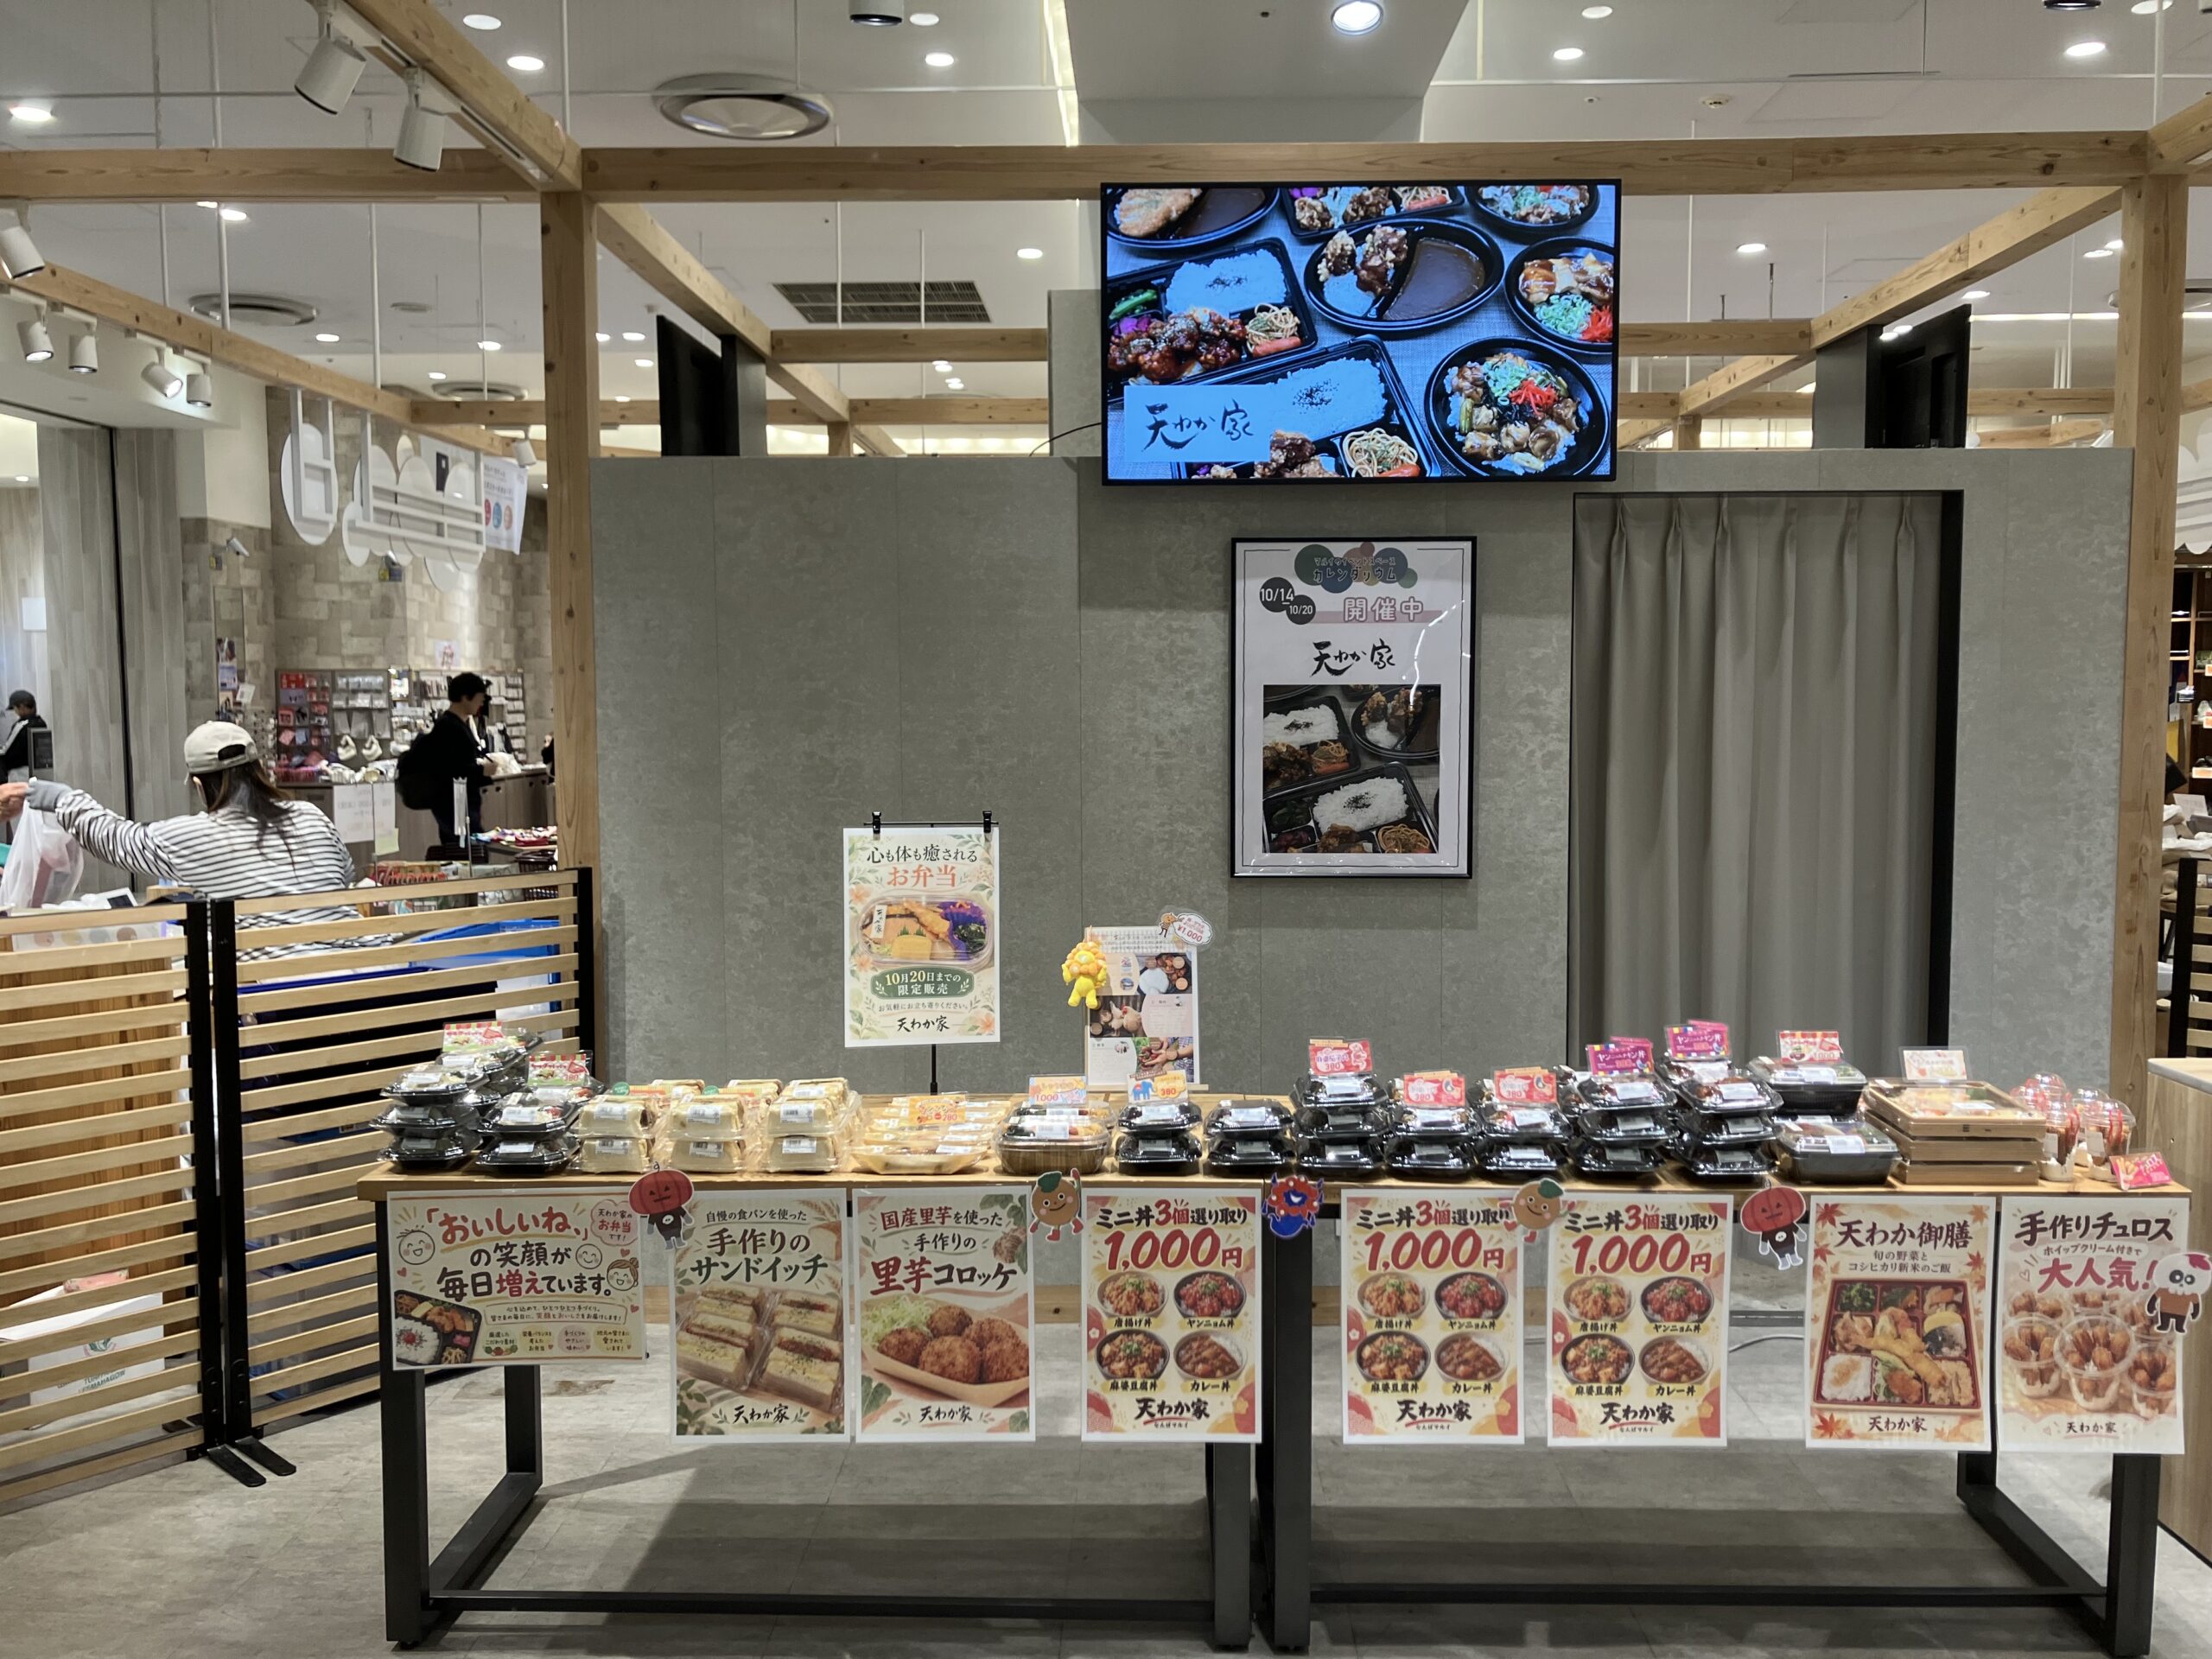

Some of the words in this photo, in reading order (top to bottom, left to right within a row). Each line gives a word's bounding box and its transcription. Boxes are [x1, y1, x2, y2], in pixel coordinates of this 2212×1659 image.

[1143, 399, 1254, 452] 天わか家
[1313, 566, 1397, 583] カレンダリウム
[1260, 588, 1294, 602] 10/14
[1288, 605, 1313, 615] 10/20
[1344, 596, 1424, 622] 開催中
[1310, 638, 1396, 677] 天わか家
[867, 844, 978, 864] 心も体も癒される
[886, 865, 957, 887] お弁当
[885, 970, 962, 986] 10月20日までの
[898, 983, 948, 996] 限定販売
[897, 1014, 950, 1033] 天わか家
[598, 1208, 632, 1219] 天わか家の
[705, 1208, 807, 1224] 自慢の食パンを使った
[880, 1206, 1004, 1231] 国産里芋を使った
[1096, 1198, 1248, 1229] ミニ丼3個選り取り
[1356, 1199, 1510, 1230] ミニ丼3個選り取り
[1564, 1204, 1719, 1233] ミニ丼3個選り取り
[598, 1219, 632, 1233] お弁当
[1834, 1219, 1974, 1250] 天わか御膳
[2014, 1210, 2174, 1246] 手作りチュロス
[706, 1227, 811, 1255] 手作りの
[913, 1233, 977, 1253] 手作りの
[1105, 1227, 1243, 1270] 1,000円
[1364, 1228, 1504, 1271] 1,000円
[2044, 1243, 2142, 1256] ホイップクリーム付きで
[470, 1240, 573, 1269] の笑顔が
[1572, 1233, 1712, 1275] 1,000円
[1873, 1250, 1929, 1262] 旬の野菜と
[690, 1254, 830, 1285] サンドイッチ
[869, 1255, 1018, 1296] 里芋コロッケ
[1848, 1262, 1952, 1274] コシヒカリ新米のご飯
[2037, 1256, 2159, 1294] 大人気!
[436, 1266, 612, 1303] 毎日増えています。
[1114, 1317, 1153, 1328] 唐揚げ丼
[1186, 1318, 1235, 1329] ヤンニョム丼
[1374, 1319, 1413, 1330] 唐揚げ丼
[1447, 1319, 1497, 1331] ヤンニョム丼
[1580, 1322, 1618, 1333] 唐揚げ丼
[1653, 1323, 1701, 1333] ヤンニョム丼
[1190, 1381, 1230, 1392] カレー丼
[1452, 1382, 1493, 1394] カレー丼
[1656, 1385, 1696, 1396] カレー丼
[732, 1403, 791, 1425] 天わか家
[918, 1405, 974, 1424] 天わか家
[1135, 1396, 1211, 1421] 天わか家
[1395, 1399, 1472, 1423] 天わか家
[1599, 1401, 1675, 1425] 天わか家
[1868, 1415, 1928, 1433] 天わか家
[2066, 1421, 2117, 1433] 天わか家
